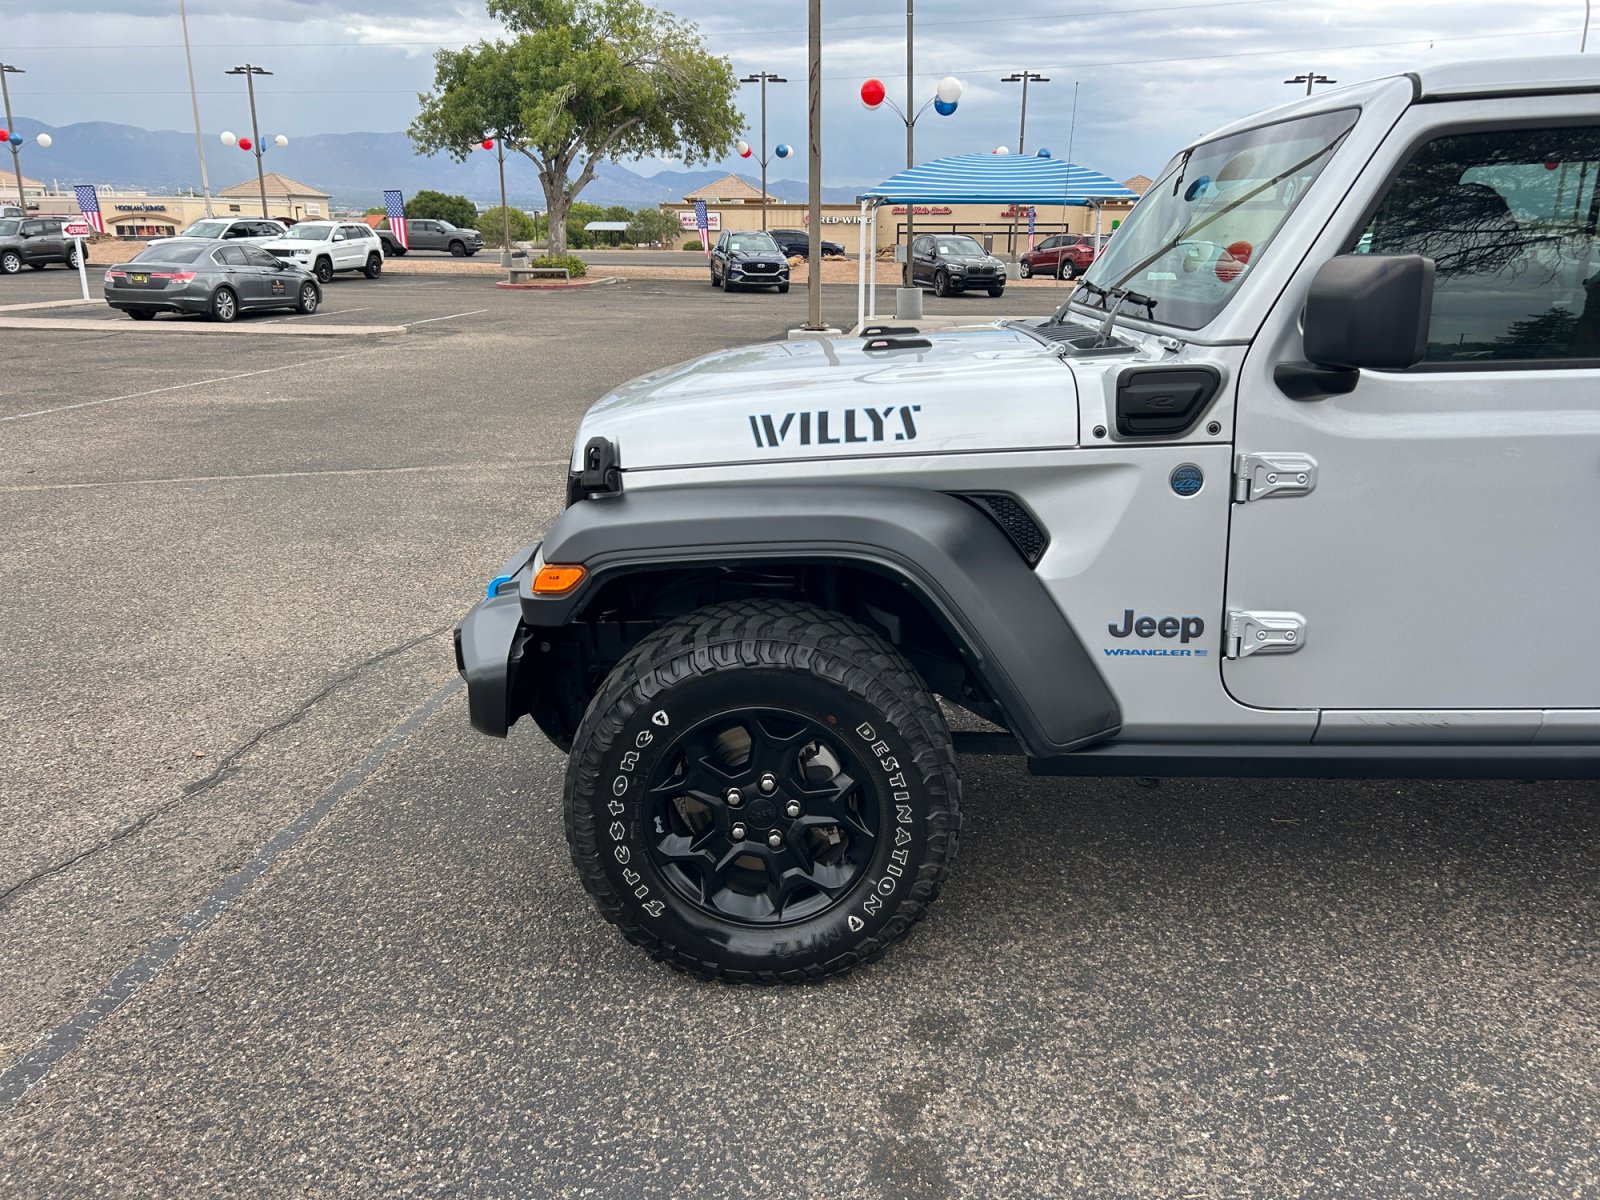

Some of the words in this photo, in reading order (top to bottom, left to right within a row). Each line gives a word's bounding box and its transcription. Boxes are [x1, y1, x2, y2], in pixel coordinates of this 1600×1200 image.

[114, 204, 143, 212] HOOKAH
[820, 216, 839, 224] RED
[69, 225, 89, 234] SERVICE
[748, 404, 921, 448] WILLYS
[1108, 609, 1204, 643] Jeep
[607, 730, 666, 918] Firestone
[856, 721, 913, 916] DESTINATION
